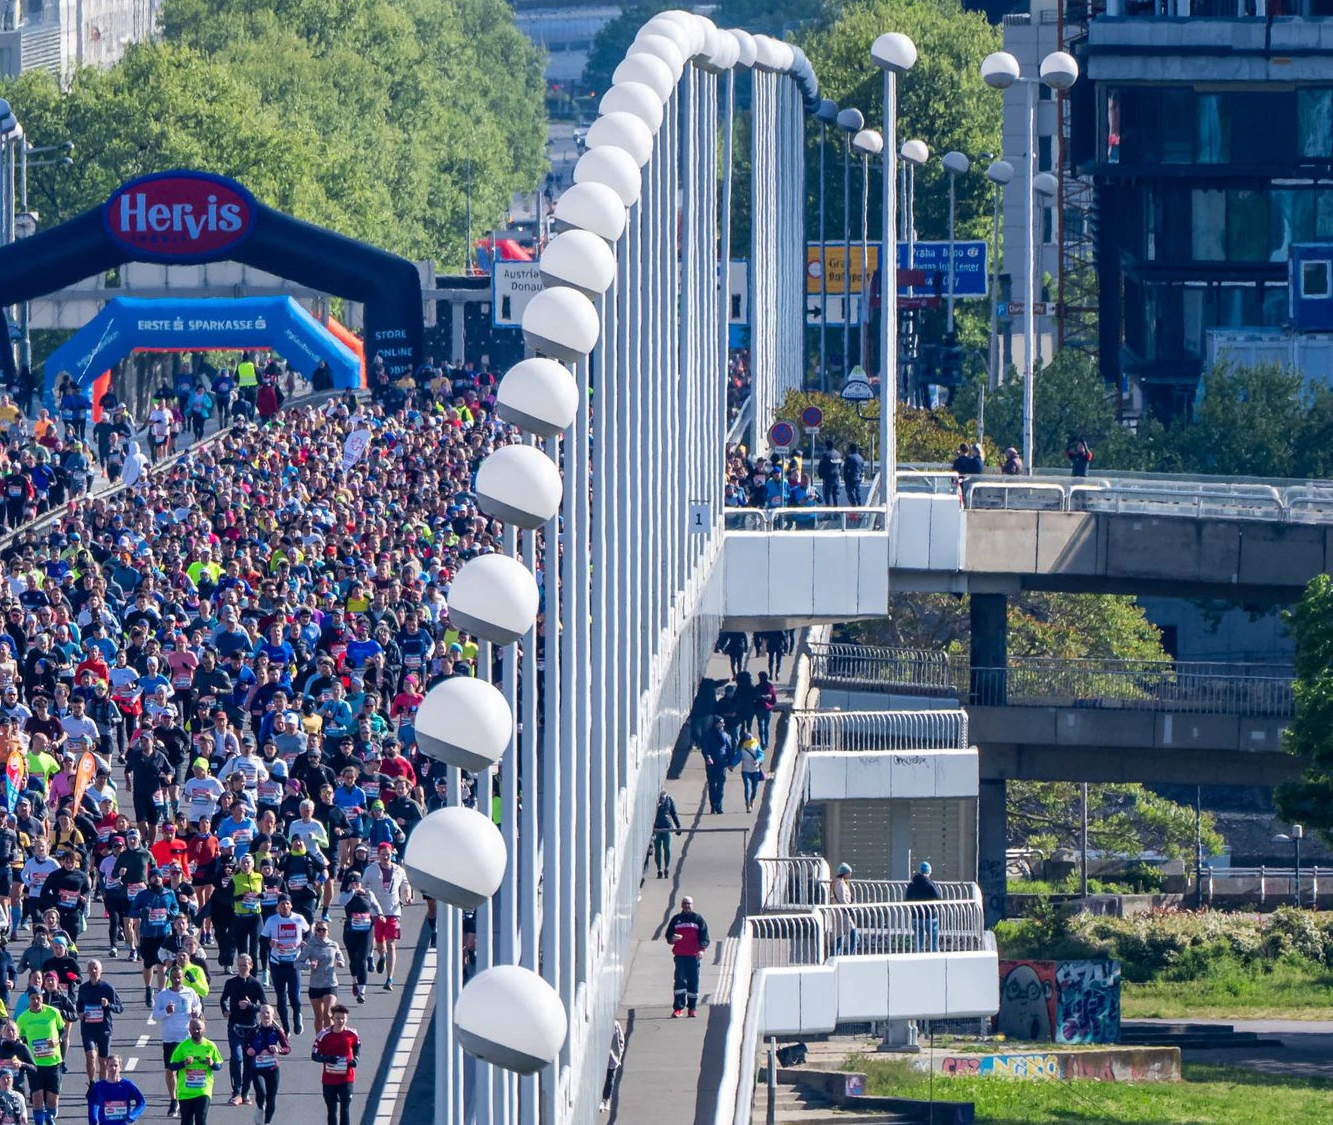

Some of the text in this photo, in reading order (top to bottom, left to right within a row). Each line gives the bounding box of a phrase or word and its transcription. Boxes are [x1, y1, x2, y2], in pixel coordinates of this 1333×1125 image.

[120, 192, 243, 240] Hervis
[942, 247, 963, 257] Bno
[138, 319, 253, 331] ERSTE SPARKASSE
[375, 329, 407, 341] STORE
[695, 513, 703, 526] 1
